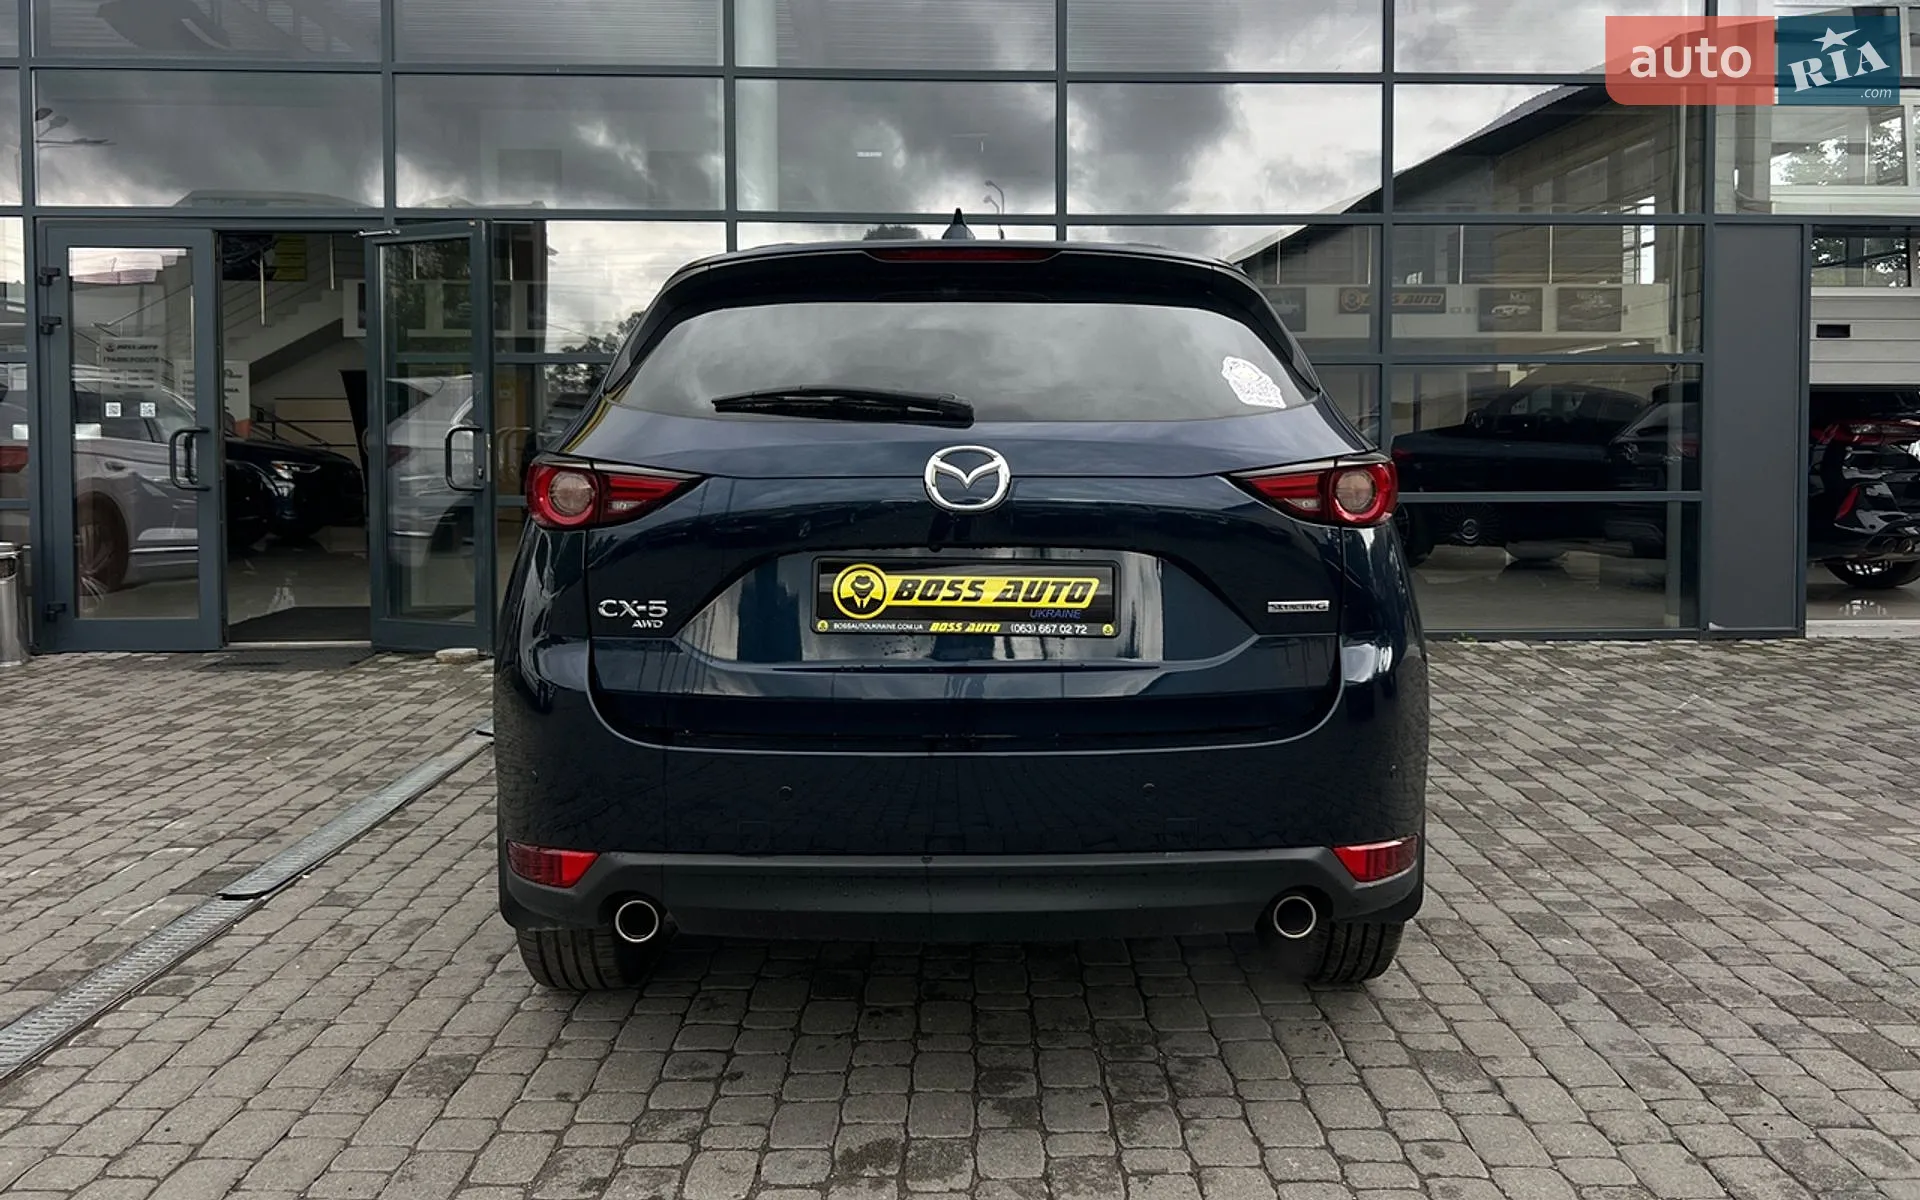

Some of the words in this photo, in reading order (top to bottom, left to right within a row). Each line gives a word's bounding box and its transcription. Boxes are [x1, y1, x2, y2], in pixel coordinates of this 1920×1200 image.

[892, 579, 985, 602] BOSS
[992, 580, 1093, 603] AUTO
[598, 599, 668, 617] CX-5
[1029, 608, 1082, 619] UKRAINE
[631, 619, 664, 629] AWD
[929, 622, 963, 632] BOSS
[965, 622, 1001, 632] AUTO
[1010, 623, 1036, 634] (063)
[1038, 623, 1057, 634] 667
[1059, 624, 1073, 634] 02
[1075, 624, 1088, 634] 72
